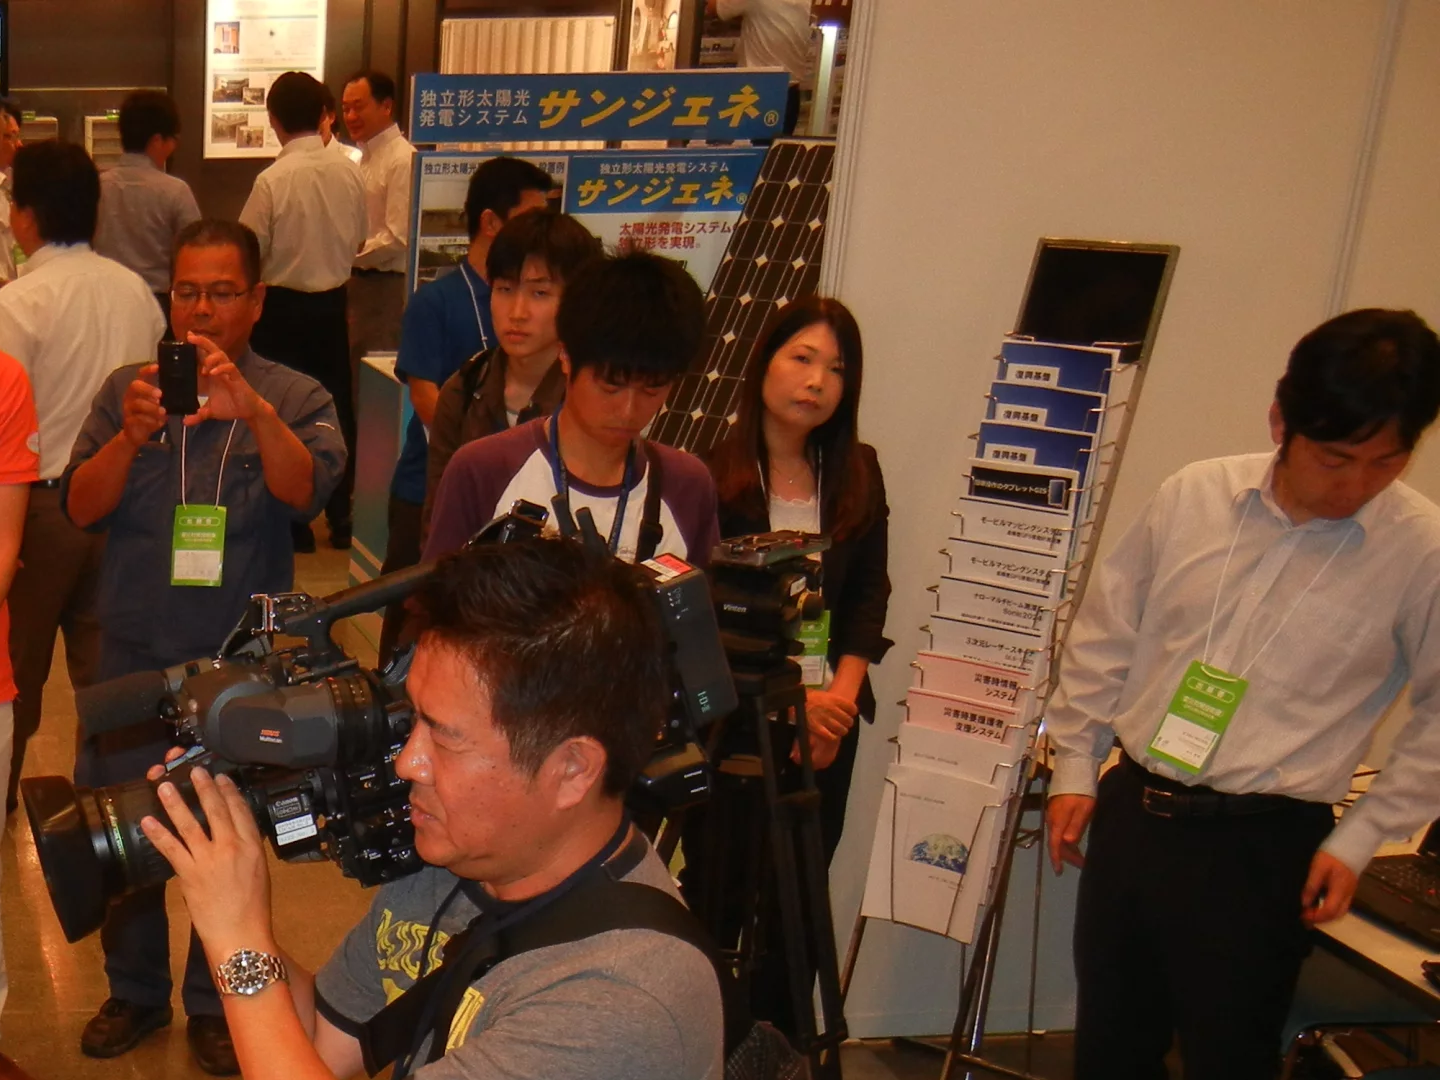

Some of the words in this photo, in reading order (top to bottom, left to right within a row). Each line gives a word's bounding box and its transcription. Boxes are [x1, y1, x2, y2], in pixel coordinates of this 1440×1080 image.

[420, 88, 531, 108] 独立形太陽光
[418, 108, 529, 127] 発電システム
[600, 162, 730, 175] 独立形太陽光発電システム
[722, 603, 747, 613] Vinten
